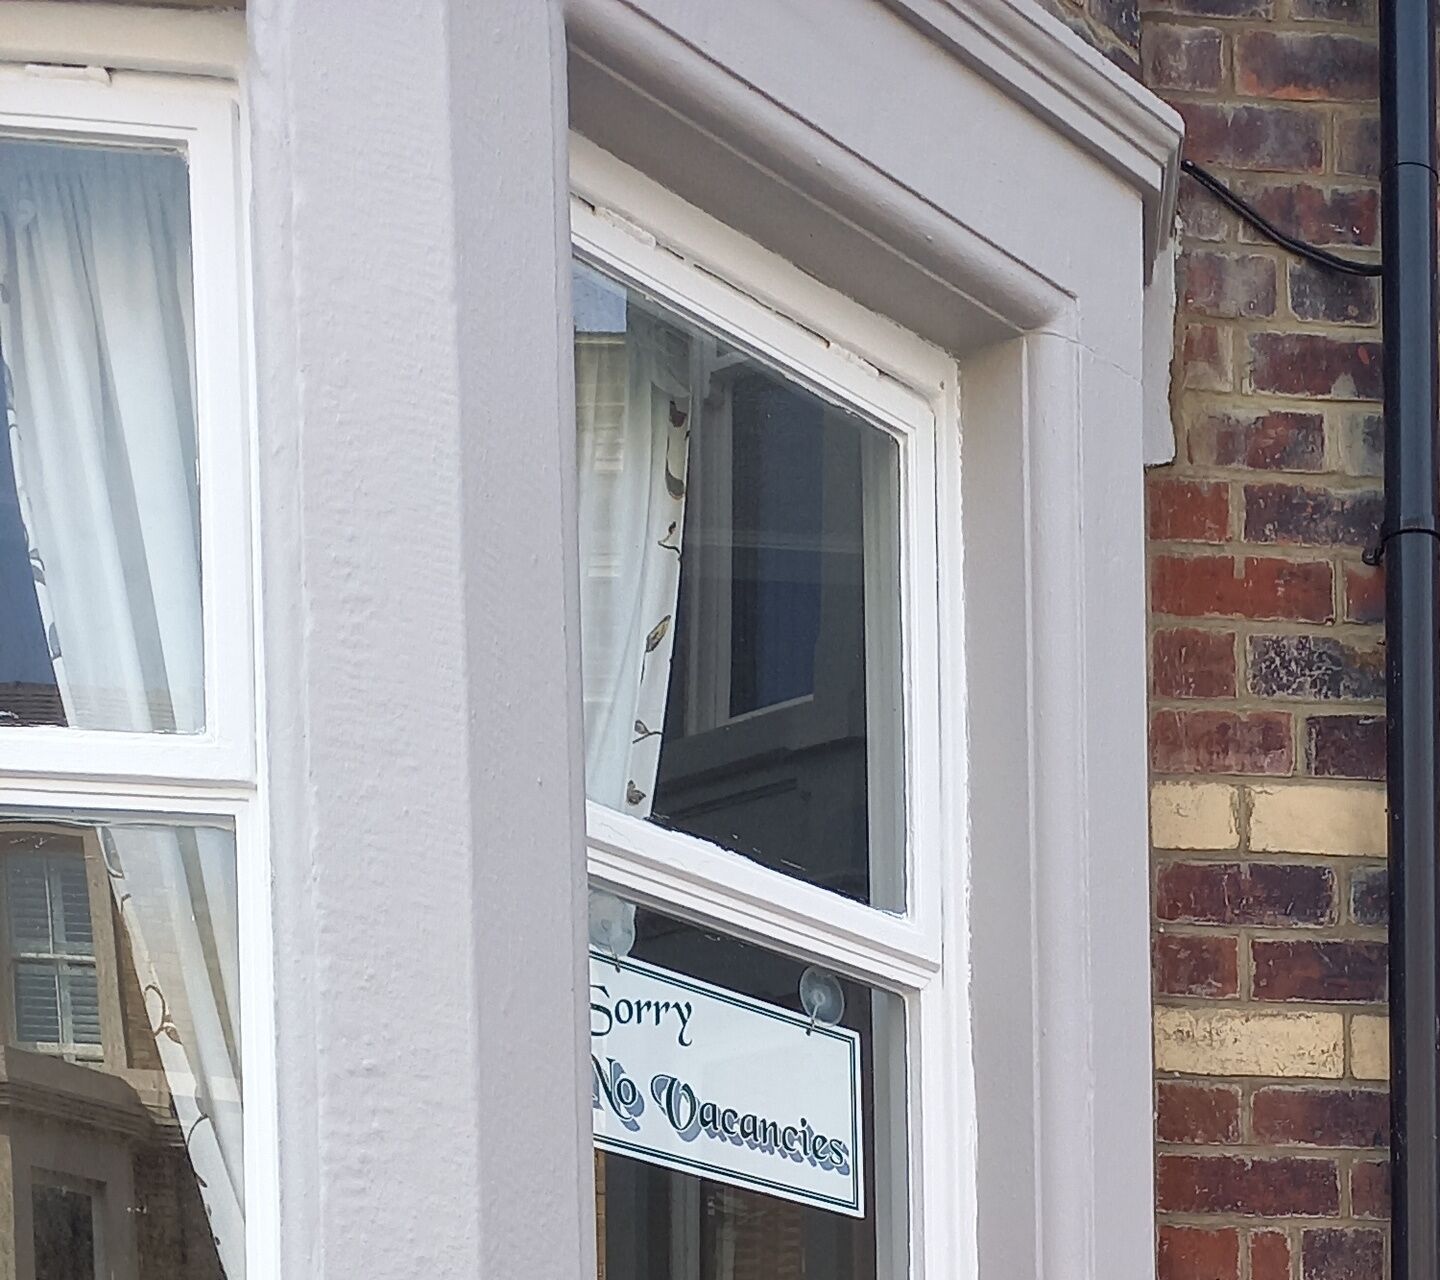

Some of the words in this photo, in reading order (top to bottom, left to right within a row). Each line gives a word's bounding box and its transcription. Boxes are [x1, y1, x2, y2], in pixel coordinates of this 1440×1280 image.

[590, 985, 693, 1047] Sorry
[592, 1054, 641, 1122] No
[650, 1073, 849, 1168] Vacancies
